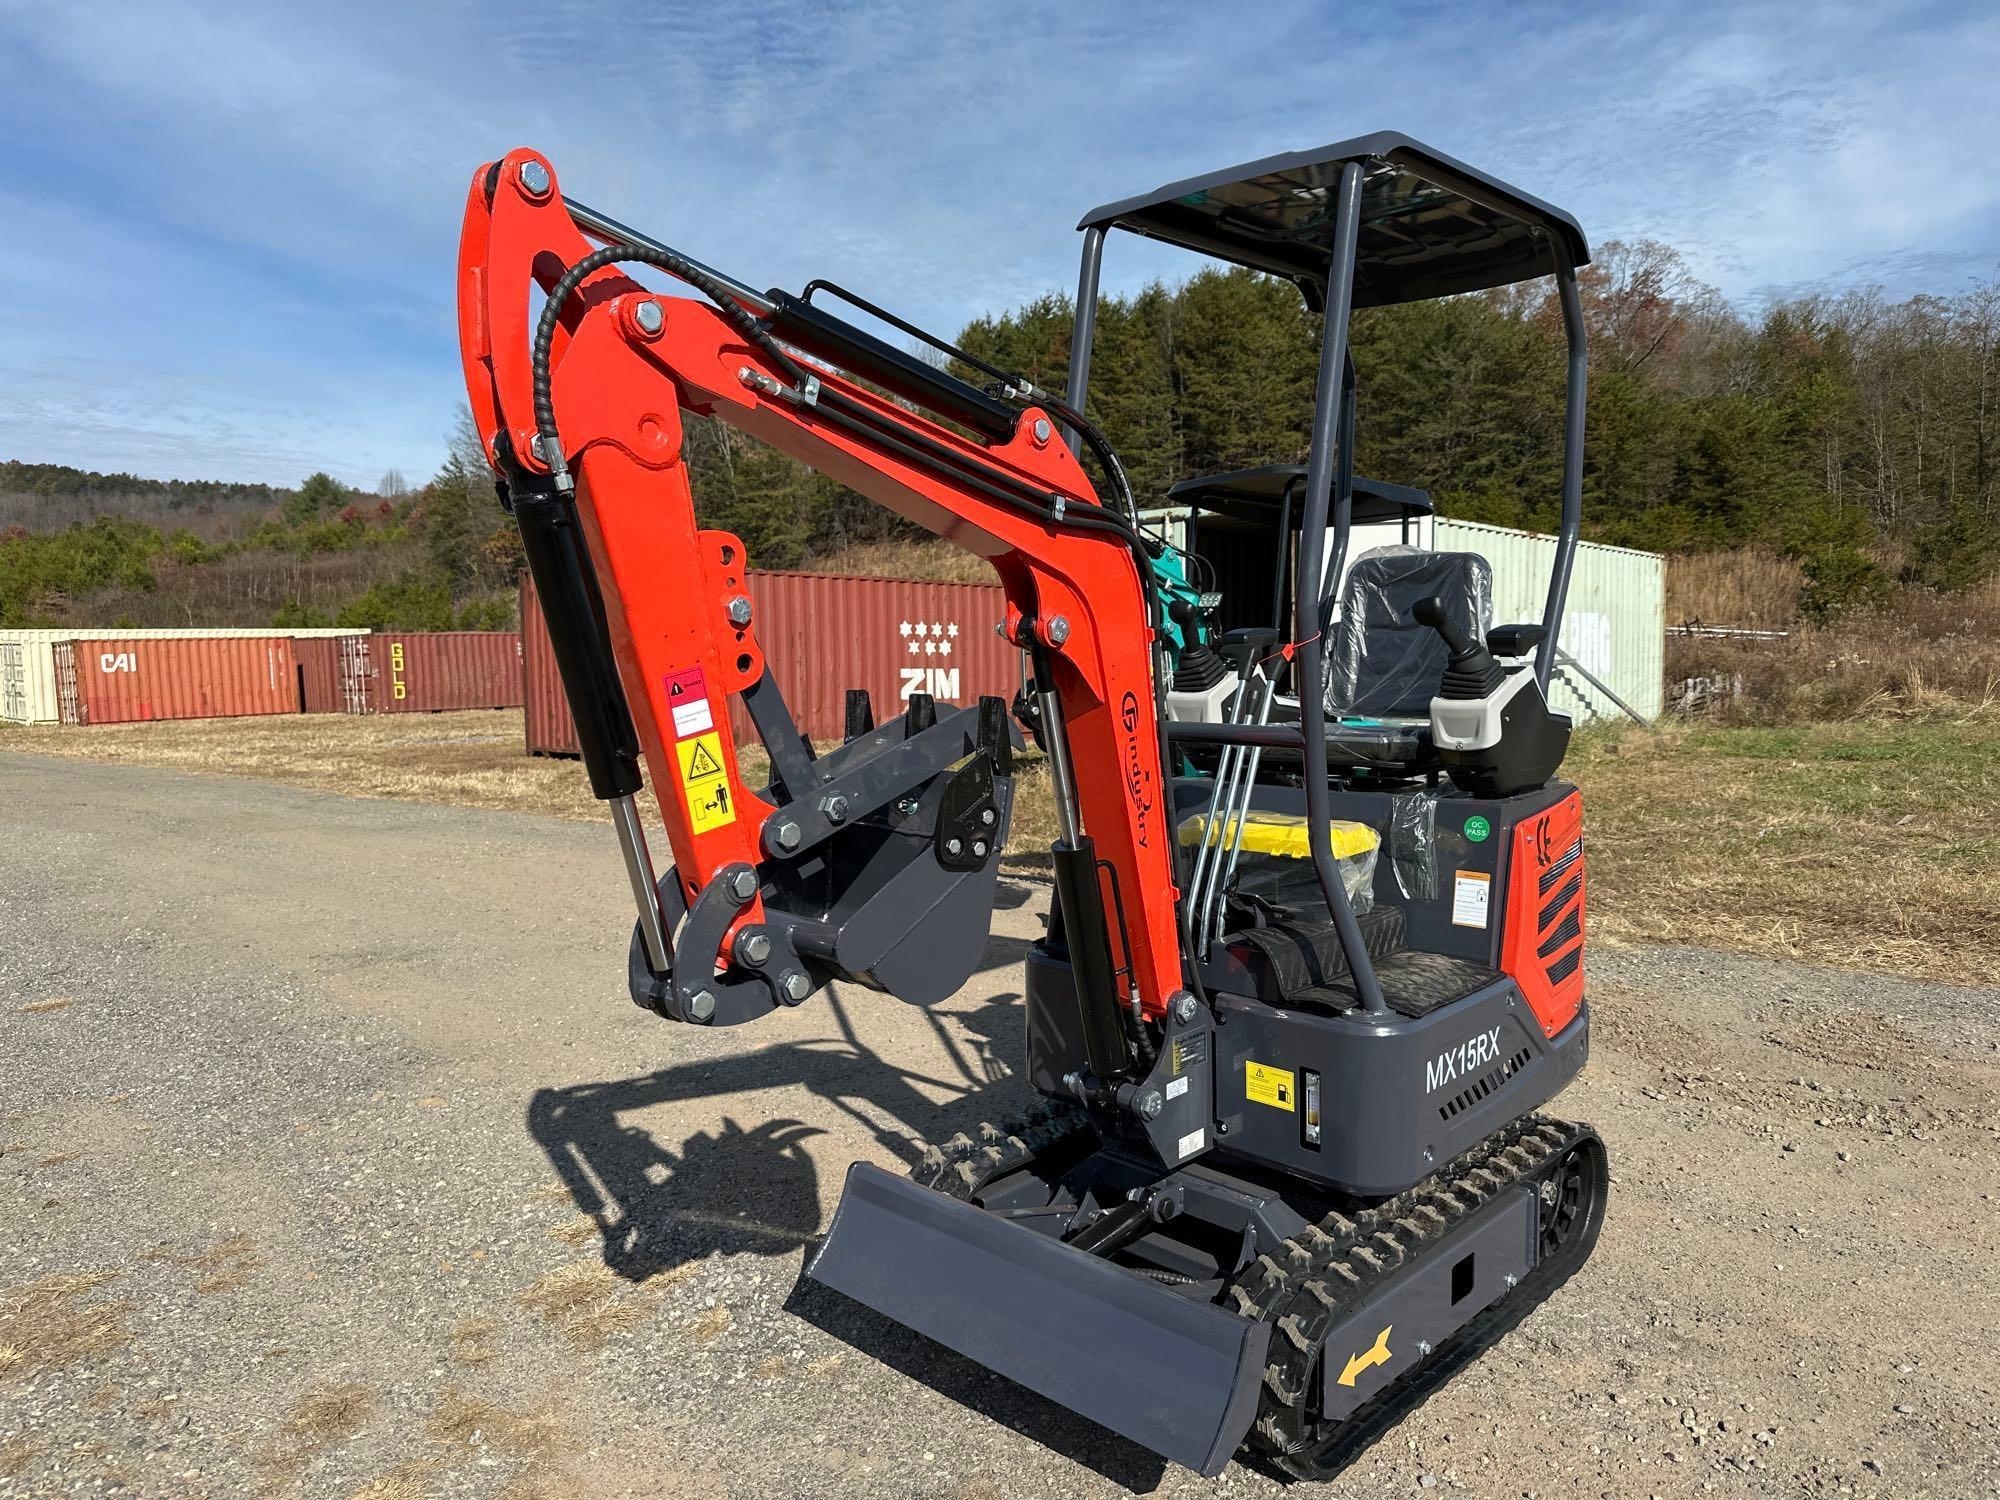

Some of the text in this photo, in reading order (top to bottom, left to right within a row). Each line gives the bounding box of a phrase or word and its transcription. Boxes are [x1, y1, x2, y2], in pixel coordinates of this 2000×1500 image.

[100, 652, 137, 673] CAI
[900, 668, 960, 701] ZIM
[1467, 828, 1487, 837] PASS
[1471, 821, 1483, 829] QC
[1426, 1025, 1501, 1094] MX15RX
